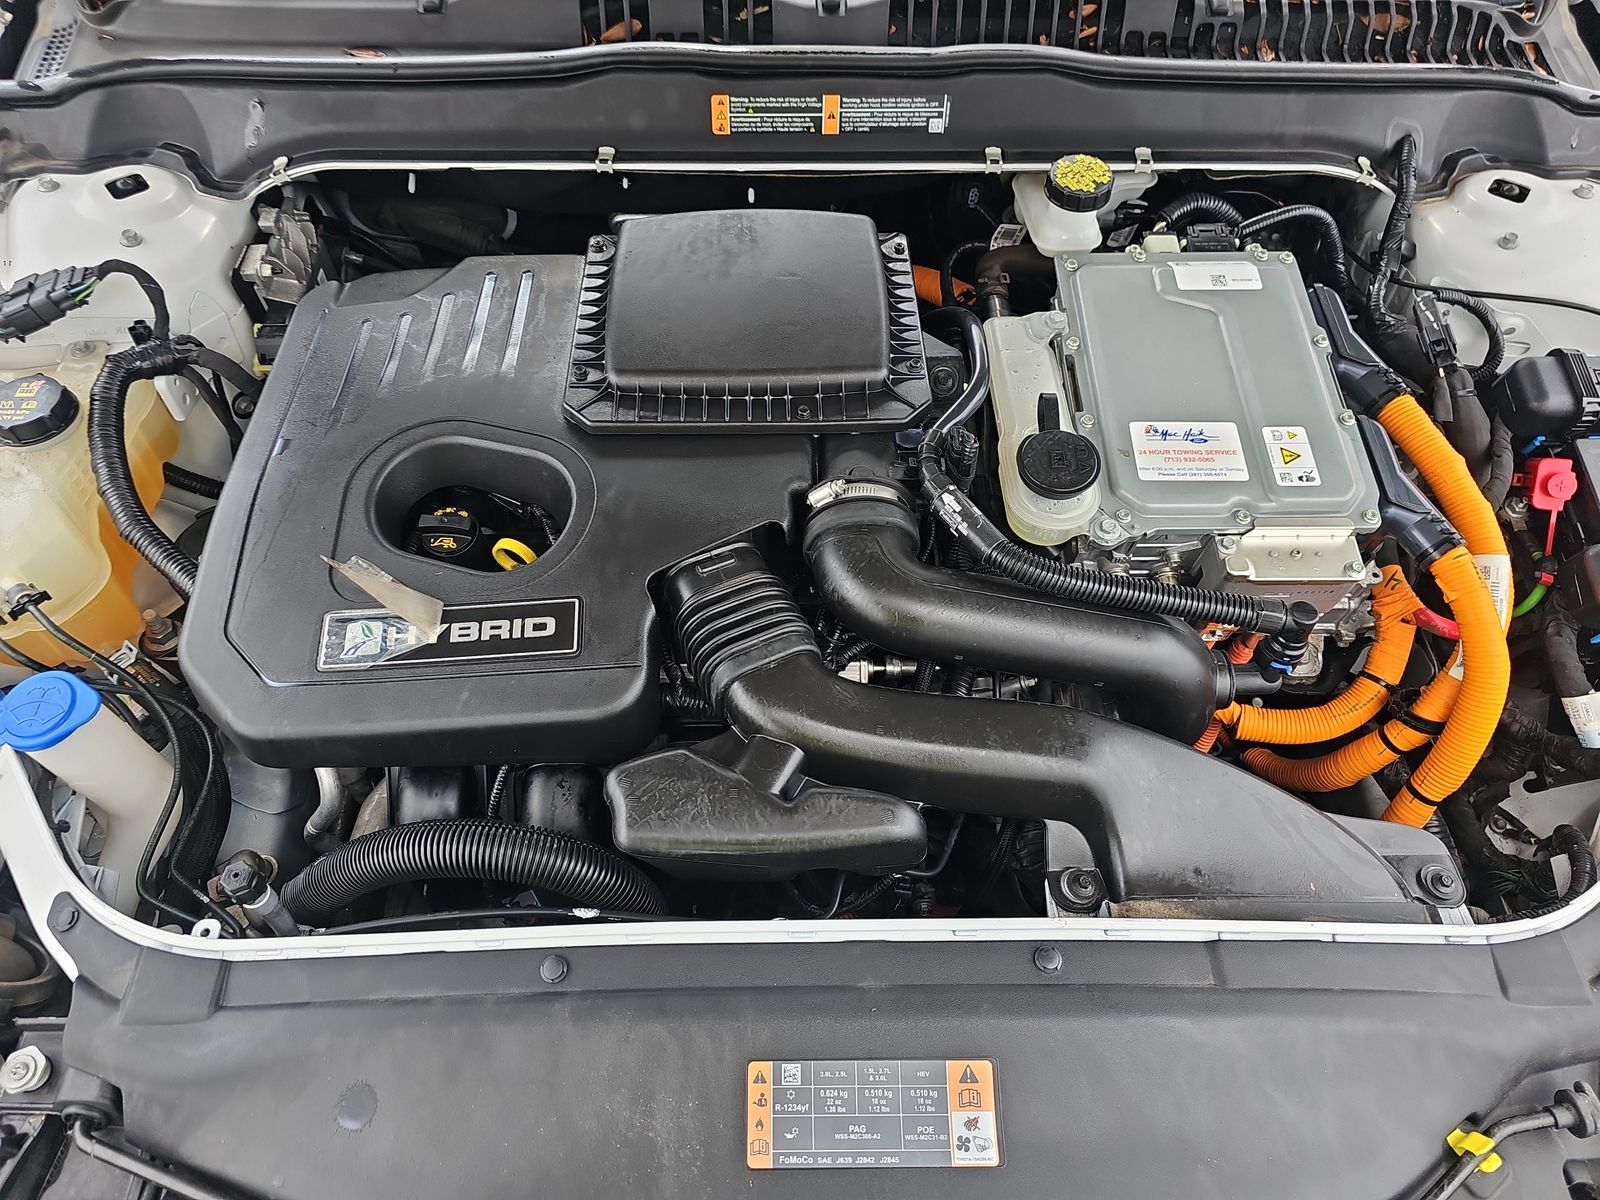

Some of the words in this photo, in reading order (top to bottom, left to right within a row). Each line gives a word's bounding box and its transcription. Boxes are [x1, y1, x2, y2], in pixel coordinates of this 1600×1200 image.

[1160, 428, 1178, 441] Mac
[1183, 428, 1206, 441] Haik
[840, 1090, 848, 1098] kg
[884, 1090, 893, 1098] kg
[929, 1090, 938, 1098] kg
[775, 1104, 809, 1113] R-1234yf
